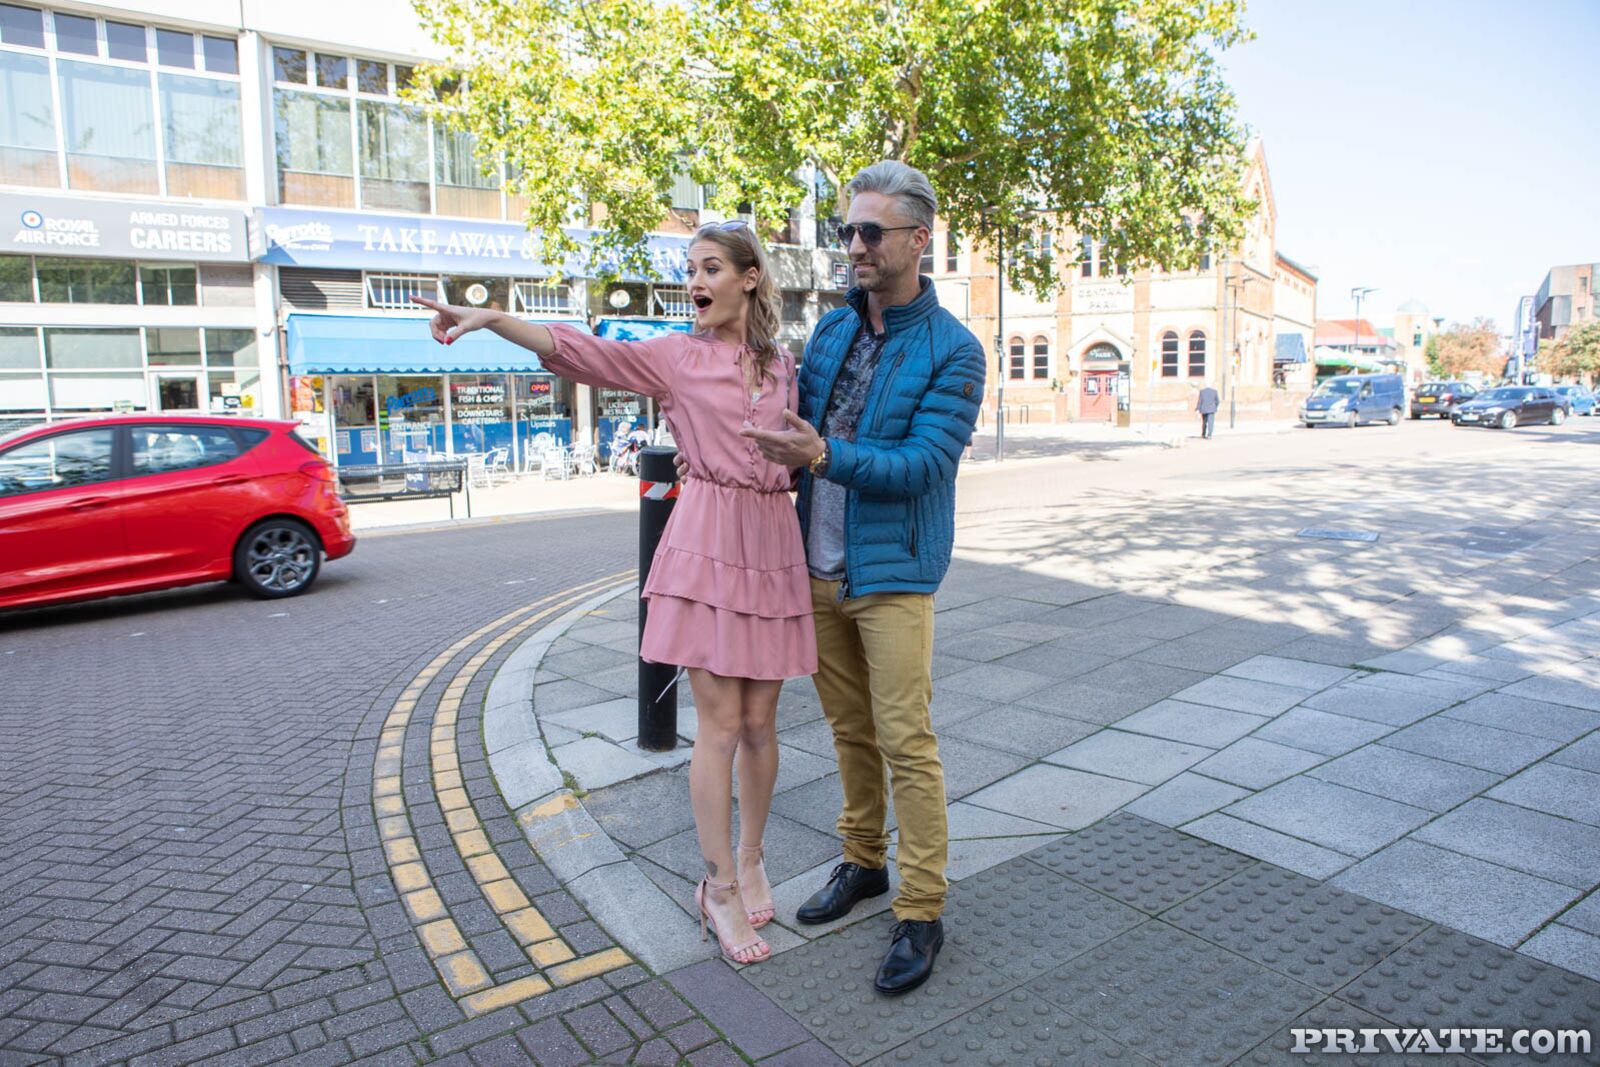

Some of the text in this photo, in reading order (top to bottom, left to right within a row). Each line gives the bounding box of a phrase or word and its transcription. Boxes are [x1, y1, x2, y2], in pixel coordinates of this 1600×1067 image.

[44, 217, 99, 233] ROYAL
[129, 211, 230, 230] ARMED FORCES
[14, 231, 100, 247] AIR FORCE
[129, 228, 232, 253] CAREERS
[358, 224, 440, 255] TAKE
[444, 231, 514, 259] AWAY
[531, 383, 550, 392] OPEN
[458, 395, 475, 403] FISH
[483, 394, 504, 403] CHIPS
[457, 409, 504, 418] DOWNSTAIRS
